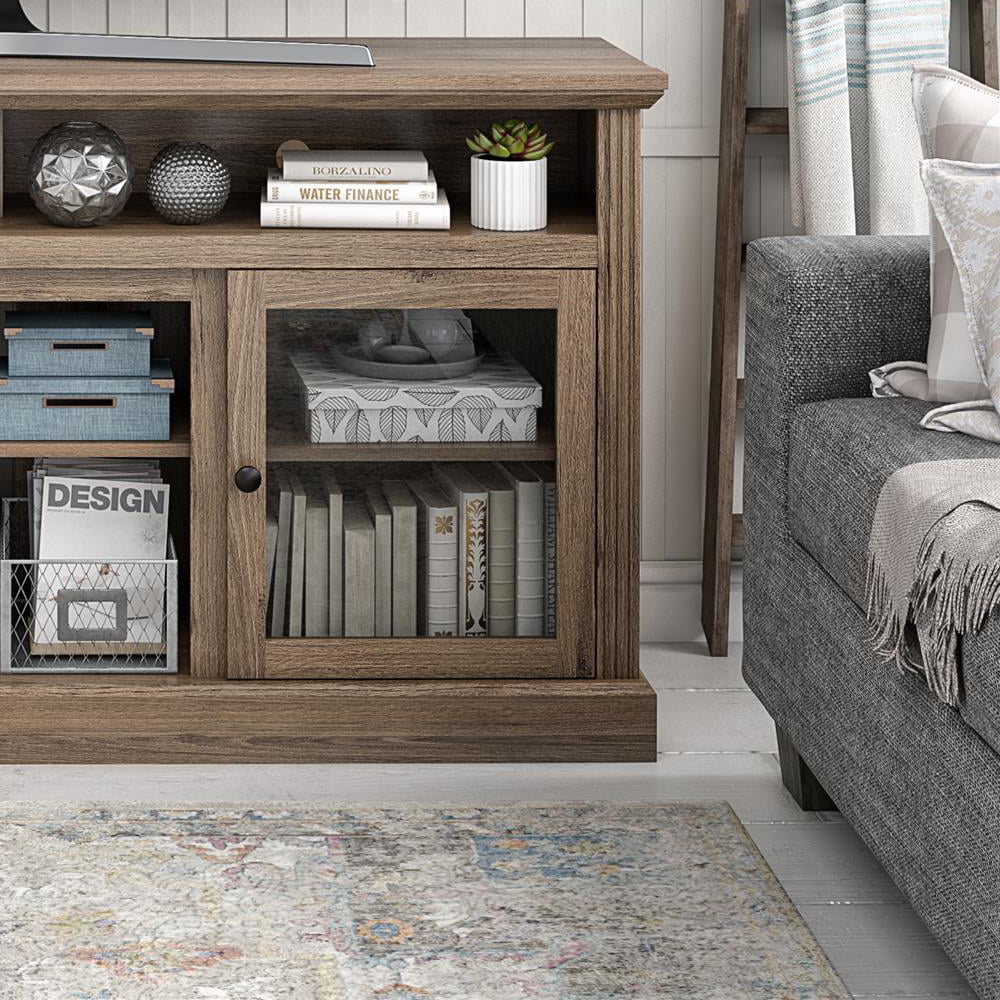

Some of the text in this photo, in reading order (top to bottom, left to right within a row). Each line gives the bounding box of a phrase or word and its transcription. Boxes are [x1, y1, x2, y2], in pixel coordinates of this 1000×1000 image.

[313, 167, 392, 176] BORZALINO
[300, 188, 400, 201] WATER FINANCE
[48, 483, 165, 515] DESIGN
